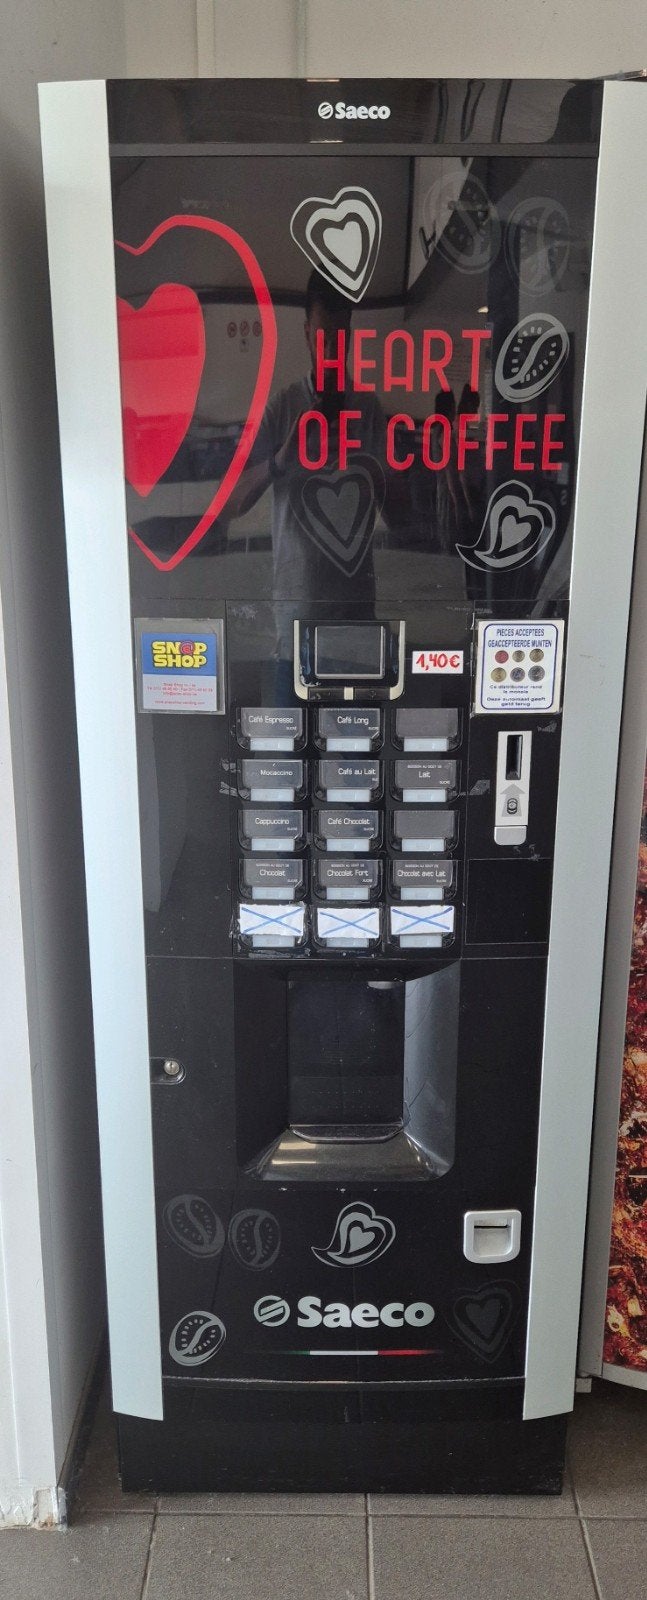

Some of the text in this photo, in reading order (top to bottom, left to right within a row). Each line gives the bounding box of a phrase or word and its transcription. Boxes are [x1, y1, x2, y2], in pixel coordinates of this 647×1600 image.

[335, 101, 391, 119] Saeco
[316, 329, 492, 392] HEART
[298, 410, 566, 471] OF COFFEE
[488, 639, 552, 648] GEACCEPTEERDE MUNTEN
[153, 654, 207, 668] SHOP
[416, 653, 460, 671] 1,40€
[248, 715, 294, 725] Café Espresso
[337, 716, 370, 726] Café Long
[337, 767, 353, 775] Café
[364, 767, 376, 775] Lait
[418, 770, 431, 778] Lait
[255, 817, 290, 826] Cappuccino
[327, 817, 370, 825] Café Chocolat
[259, 869, 286, 877] Chocolat
[327, 869, 369, 877] Chocolat Fort
[397, 869, 421, 877] Chocolat
[435, 869, 447, 877] Lait
[297, 1295, 435, 1328] Saeco
